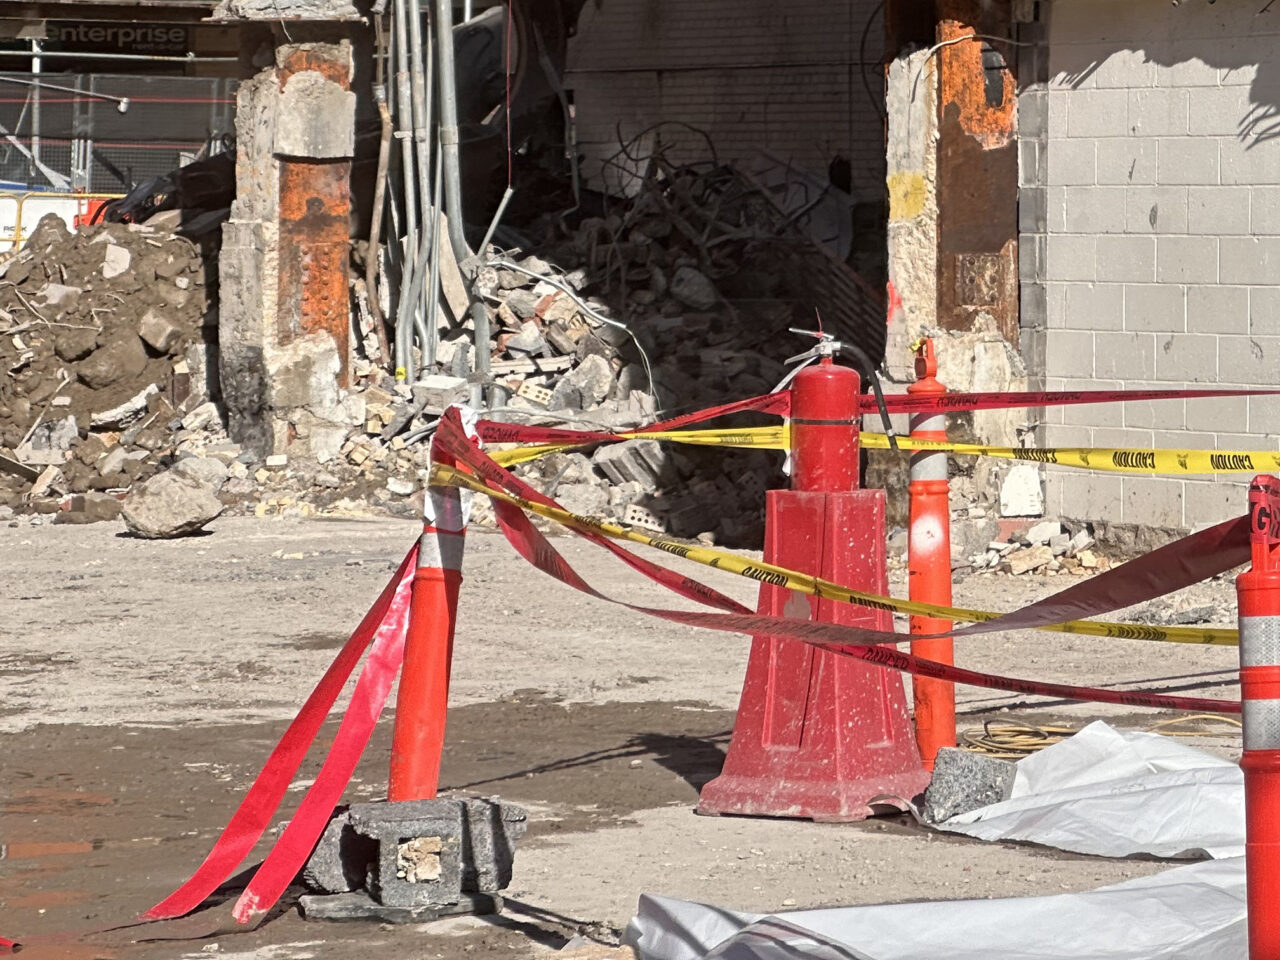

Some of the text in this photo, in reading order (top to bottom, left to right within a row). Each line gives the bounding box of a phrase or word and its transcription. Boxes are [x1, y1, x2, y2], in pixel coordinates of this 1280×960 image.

[46, 24, 186, 47] enterprise
[1112, 451, 1155, 469] CAUTION
[1210, 454, 1254, 469] CAUTION
[742, 566, 788, 587] CAUTION
